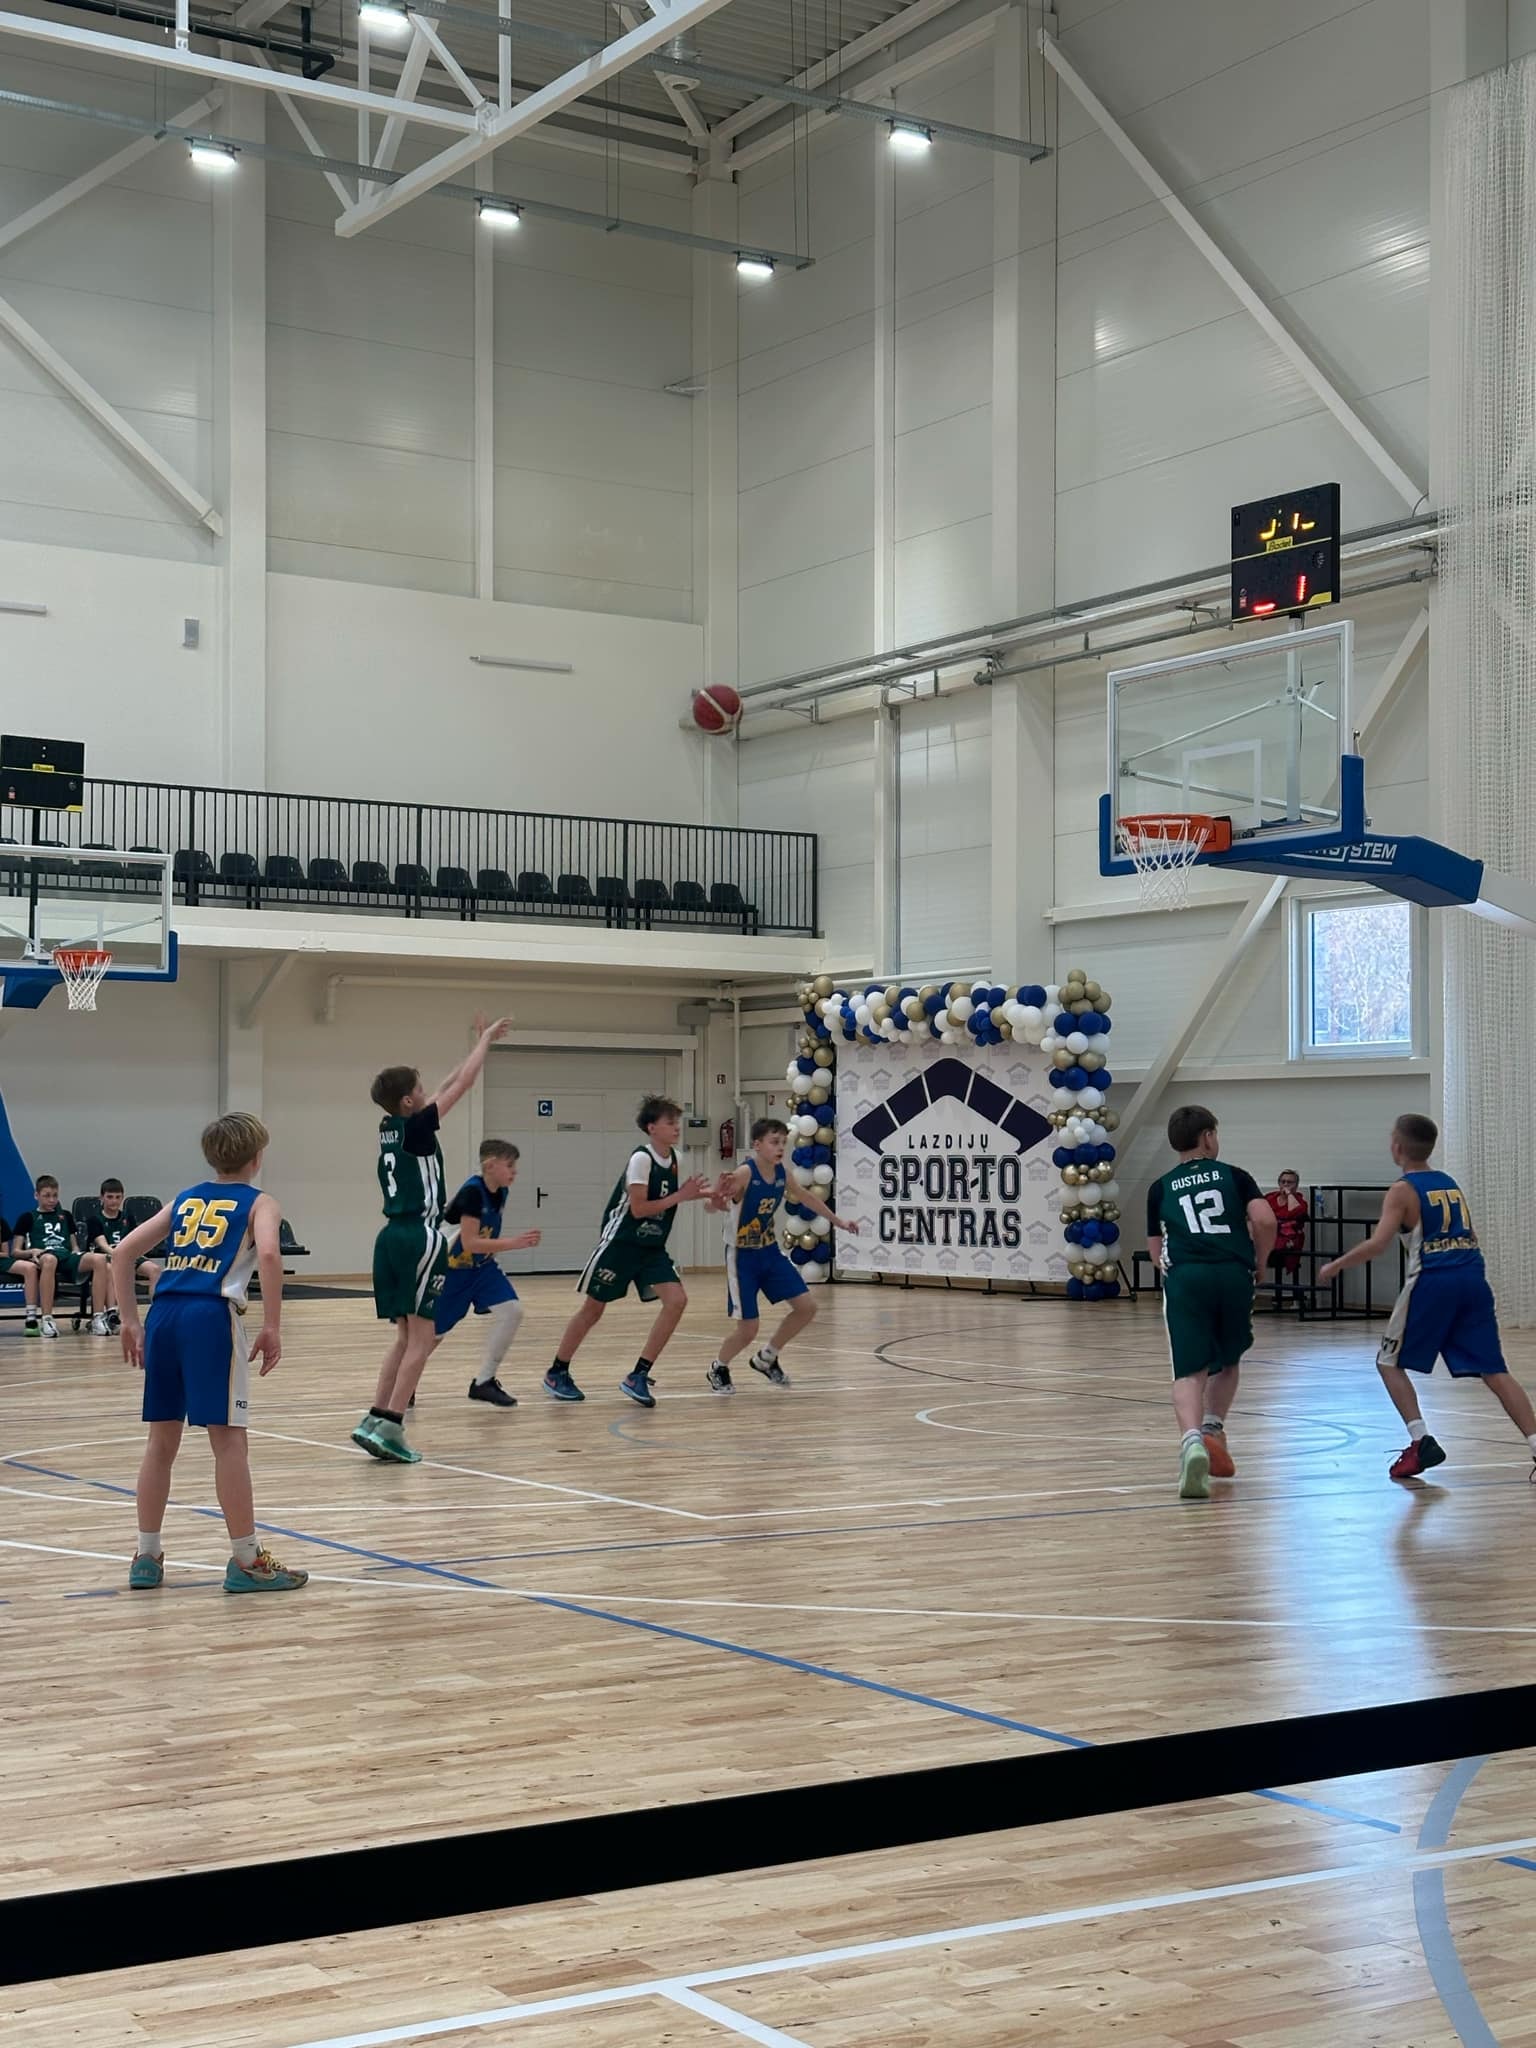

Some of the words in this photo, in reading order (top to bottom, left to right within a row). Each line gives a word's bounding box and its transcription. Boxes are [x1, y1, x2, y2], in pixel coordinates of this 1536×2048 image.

[908, 1133, 990, 1153] LAZDIJŲ
[384, 1152, 398, 1197] 3
[660, 1180, 669, 1197] 6
[879, 1154, 1022, 1203] SPORTO
[1171, 1172, 1210, 1191] GUSTAS
[1212, 1170, 1224, 1181] B.
[174, 1198, 238, 1248] 35
[758, 1198, 776, 1214] 23
[879, 1205, 1022, 1248] CENTRAS
[1178, 1189, 1231, 1233] 12
[1426, 1189, 1471, 1232] 77
